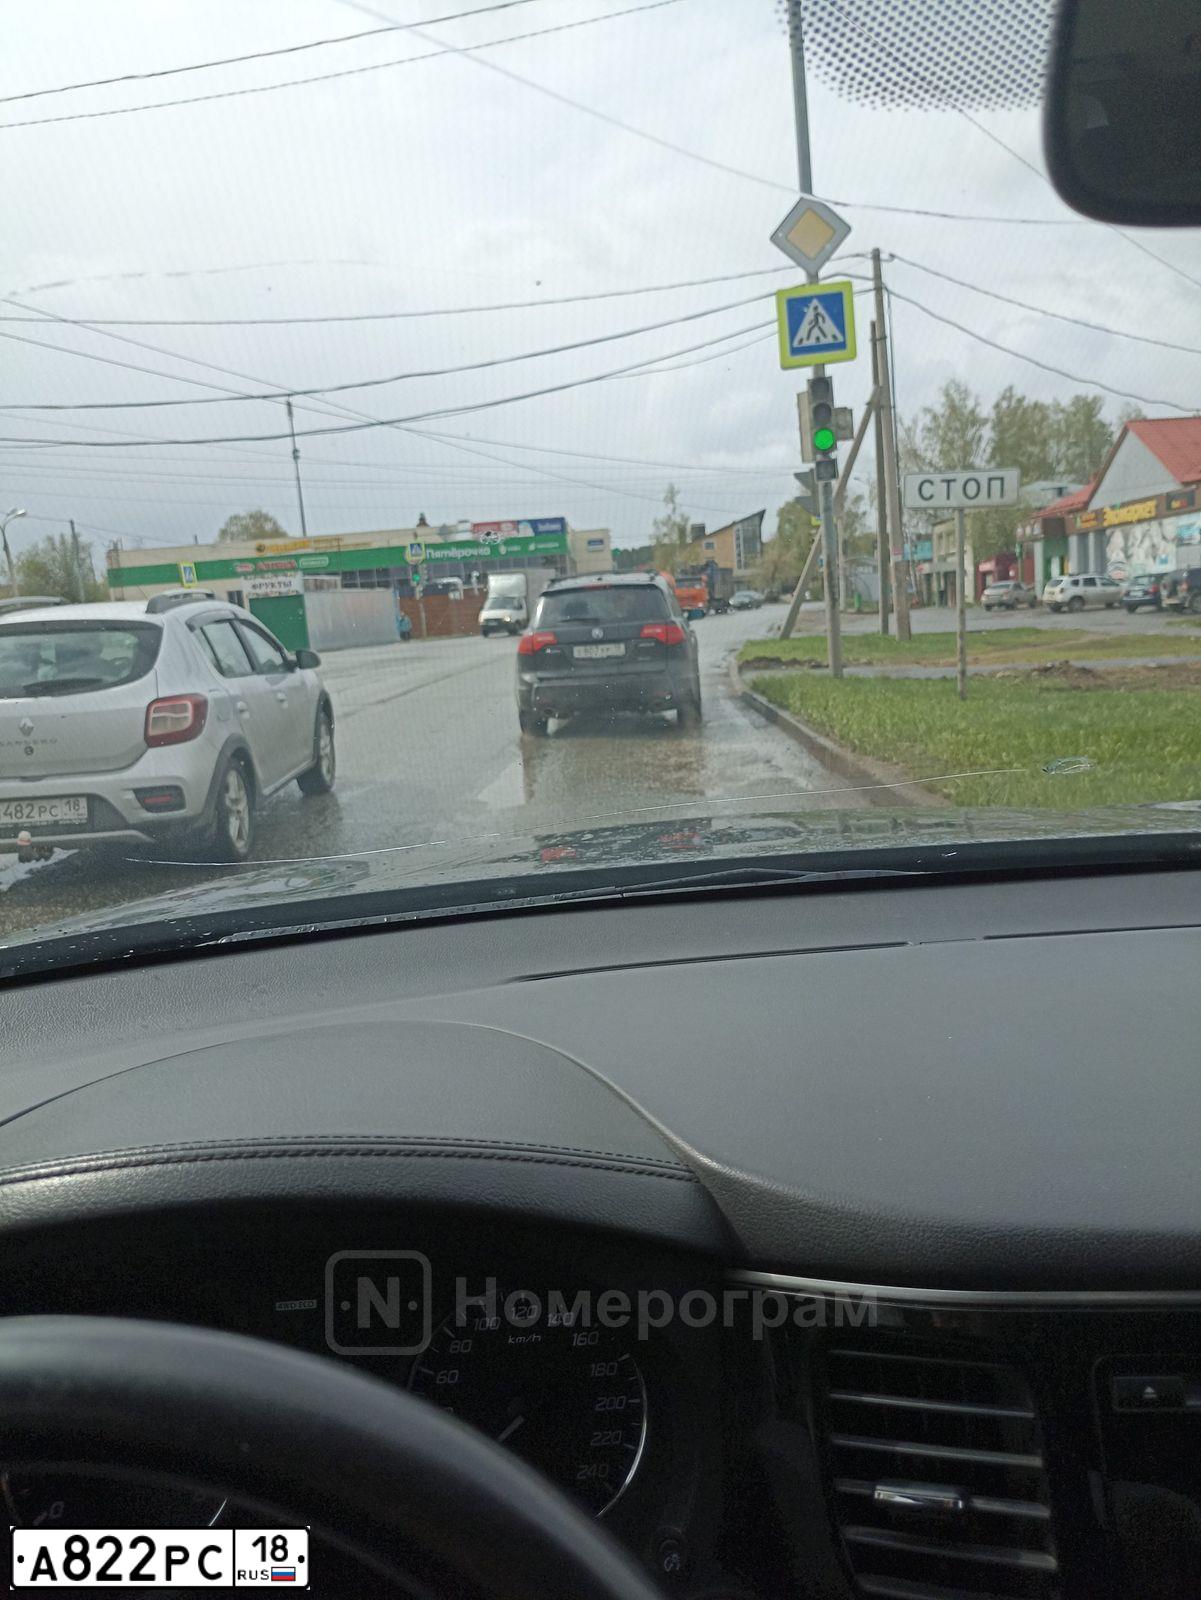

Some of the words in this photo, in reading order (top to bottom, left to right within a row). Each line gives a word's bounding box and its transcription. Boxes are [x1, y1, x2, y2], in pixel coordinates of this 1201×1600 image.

[917, 476, 1005, 501] СТОП
[426, 545, 491, 559] Пятёрочка
[252, 581, 293, 590] ФРУКТЫ
[0, 802, 59, 820] 482РС
[64, 799, 81, 812] 18
[449, 1338, 473, 1354] 80
[508, 1332, 542, 1344] km/h
[571, 1331, 599, 1346] 160
[435, 1369, 459, 1384] 60
[590, 1361, 618, 1377] 180
[594, 1395, 627, 1411] 200
[590, 1430, 622, 1446] 220
